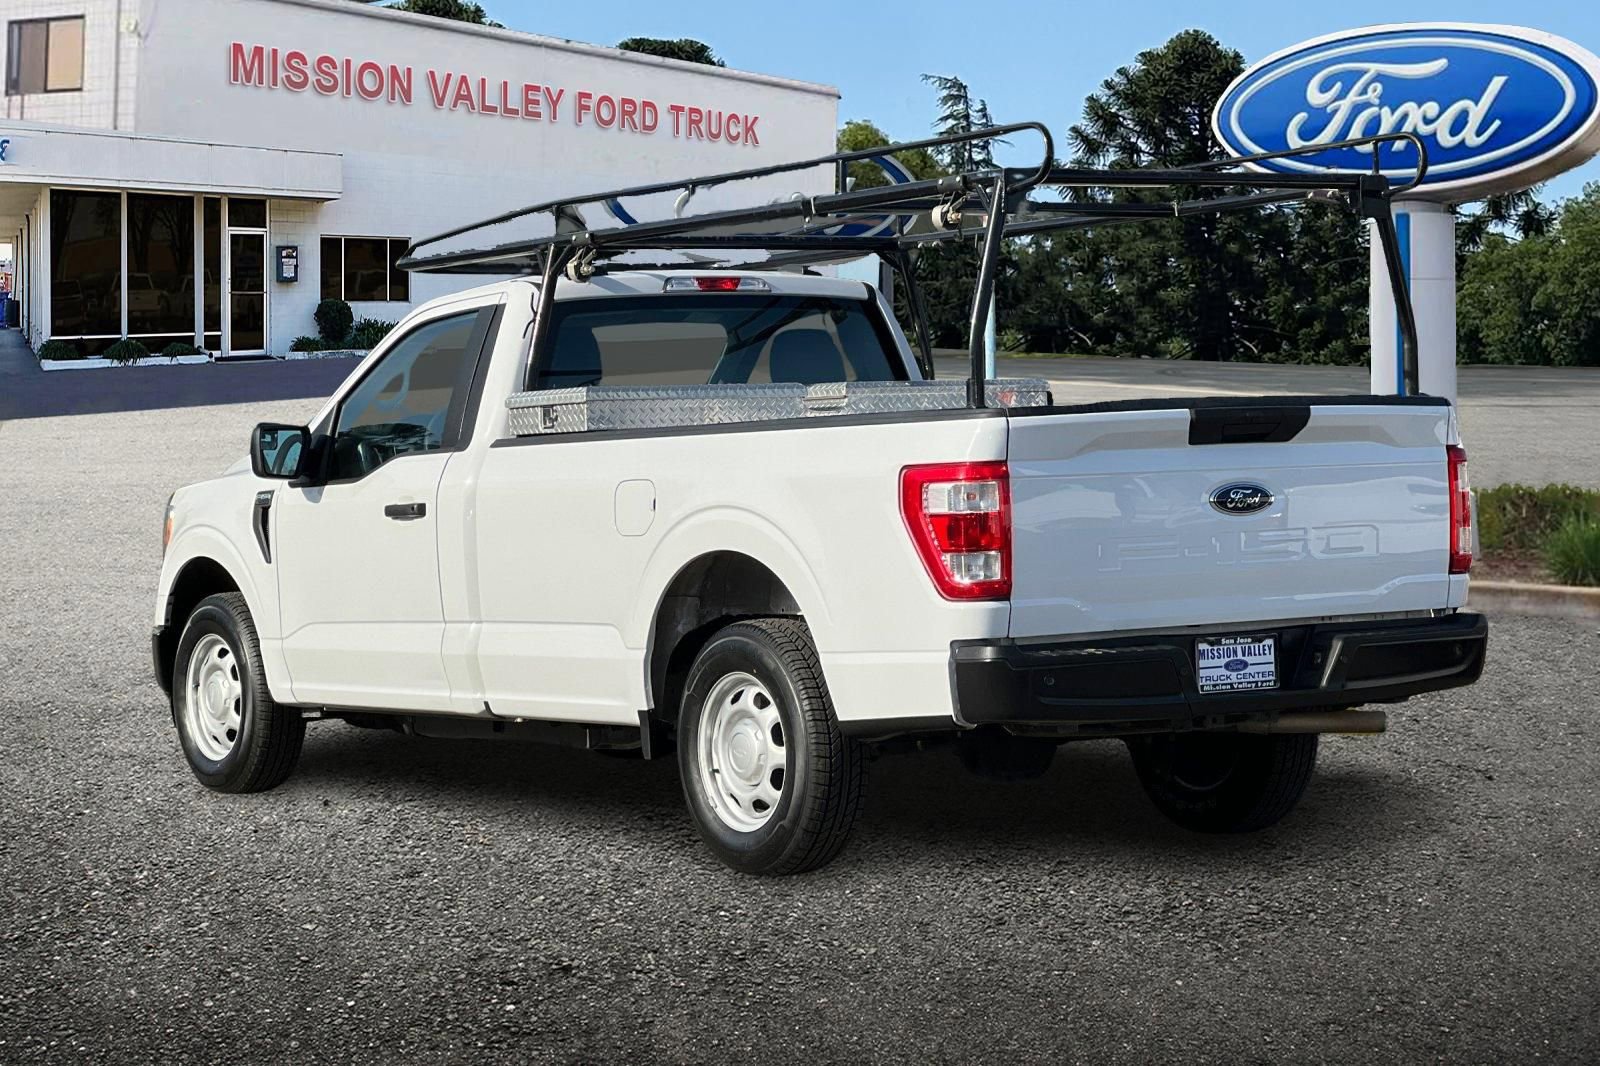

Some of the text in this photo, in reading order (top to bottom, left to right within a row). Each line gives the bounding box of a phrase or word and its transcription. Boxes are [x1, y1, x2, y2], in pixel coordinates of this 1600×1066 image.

[230, 41, 760, 146] MISSION VALLEY FORD TRUCK
[1286, 58, 1509, 155] Ford
[1226, 489, 1261, 508] Ford
[1098, 524, 1379, 571] F-150
[1199, 643, 1273, 660] MISSION VALLEY
[1200, 671, 1274, 683] TRUCK CENTER
[1233, 681, 1256, 689] Valley
